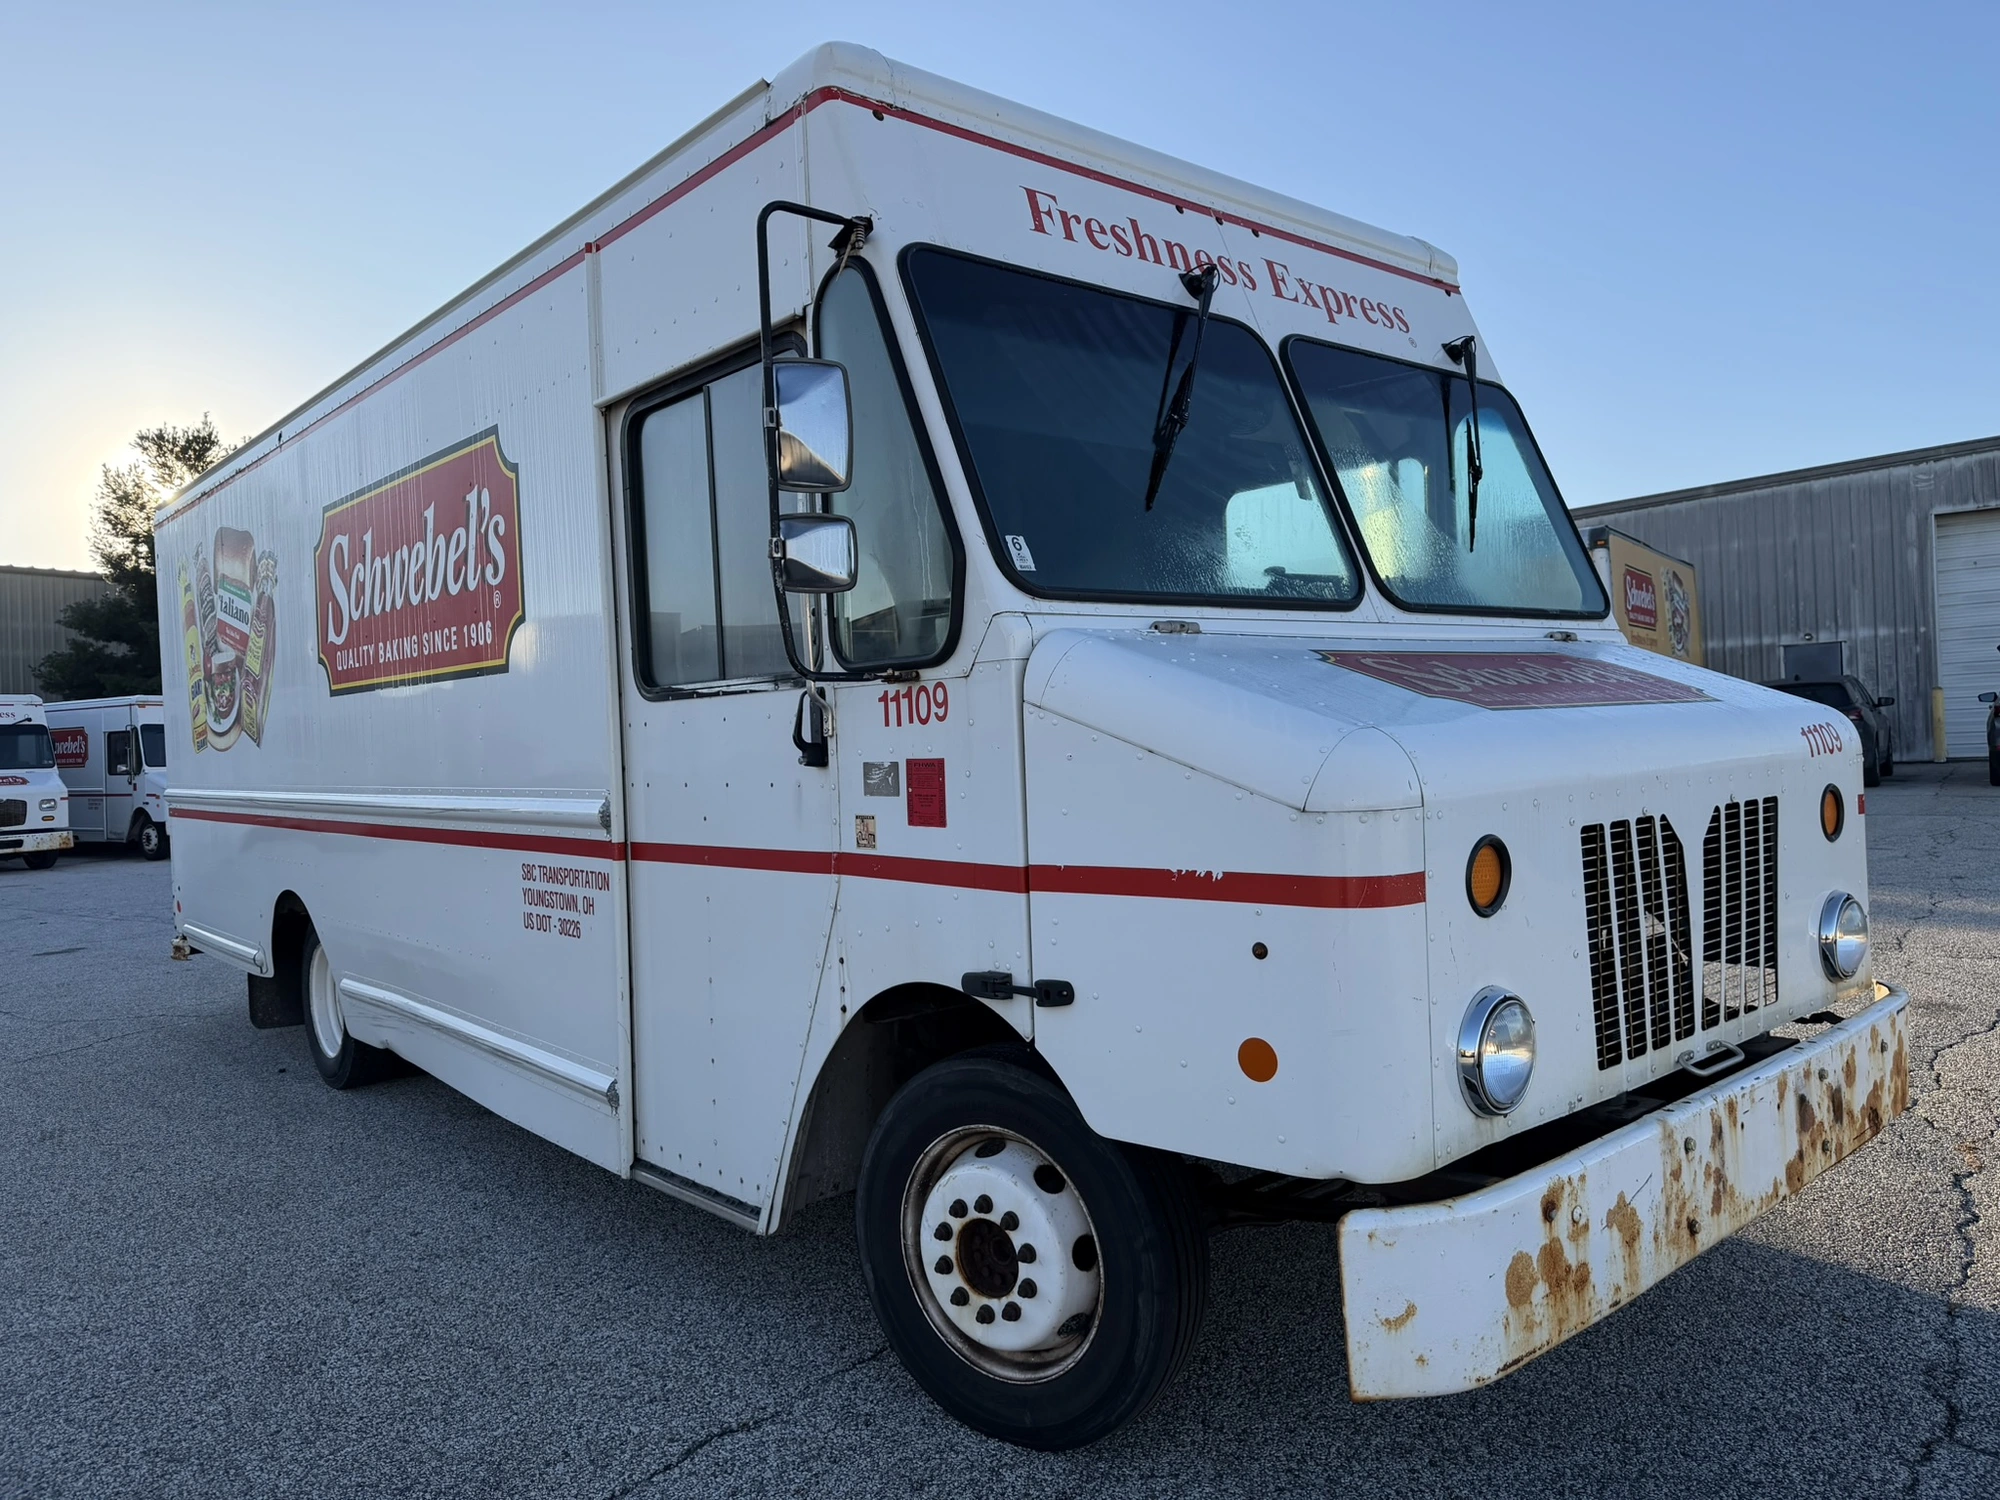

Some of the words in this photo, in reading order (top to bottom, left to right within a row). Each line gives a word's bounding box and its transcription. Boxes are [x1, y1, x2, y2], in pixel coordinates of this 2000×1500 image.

[1019, 185, 1257, 291] Freshness
[1261, 257, 1410, 334] Express
[1012, 536, 1022, 551] 6
[327, 484, 505, 646] Schwebel's
[336, 644, 375, 671] QUALITY
[379, 632, 418, 664] BAKING
[423, 626, 457, 655] SINCE
[463, 620, 492, 648] 1906
[878, 681, 948, 727] 11109
[1800, 722, 1842, 757] 11109
[521, 863, 537, 882] SBC
[538, 865, 610, 891] TRANSPORTATION
[522, 887, 581, 917] YOUNGSTOWN,
[582, 896, 595, 915] OH
[523, 911, 535, 930] US
[536, 913, 551, 933] DOT
[558, 917, 581, 939] 30226
